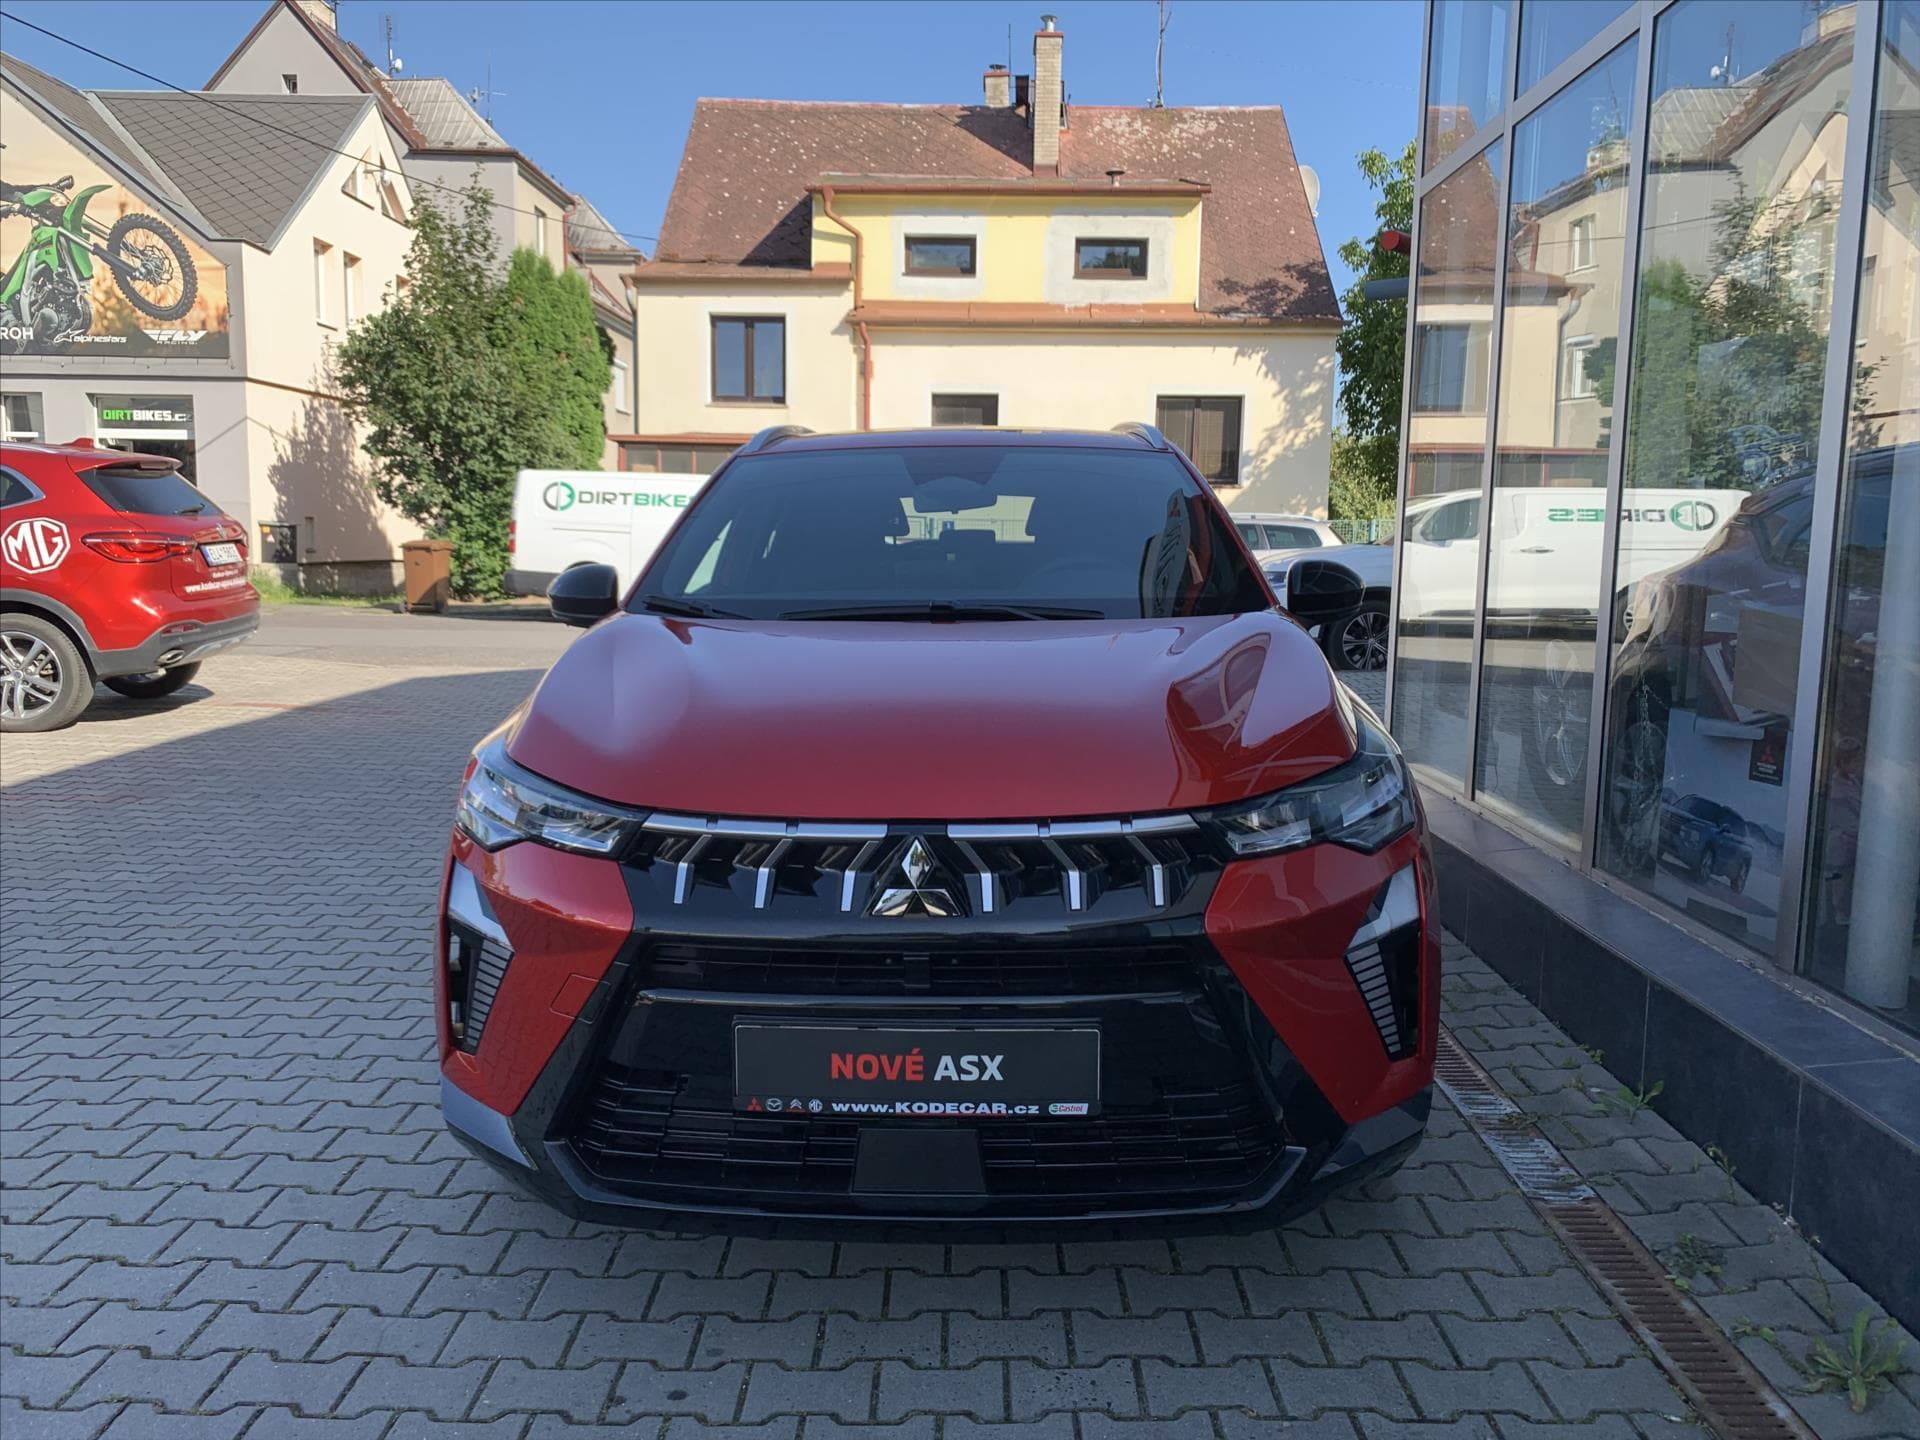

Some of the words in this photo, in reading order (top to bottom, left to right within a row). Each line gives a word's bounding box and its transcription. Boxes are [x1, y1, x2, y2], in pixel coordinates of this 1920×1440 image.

[0, 326, 34, 340] ROH
[73, 334, 127, 343] alpinestars
[4, 519, 64, 569] MG
[831, 1048, 925, 1081] NOVÉ
[933, 1055, 1004, 1081] ASX
[831, 1102, 1040, 1115] www.KODECAR.cz
